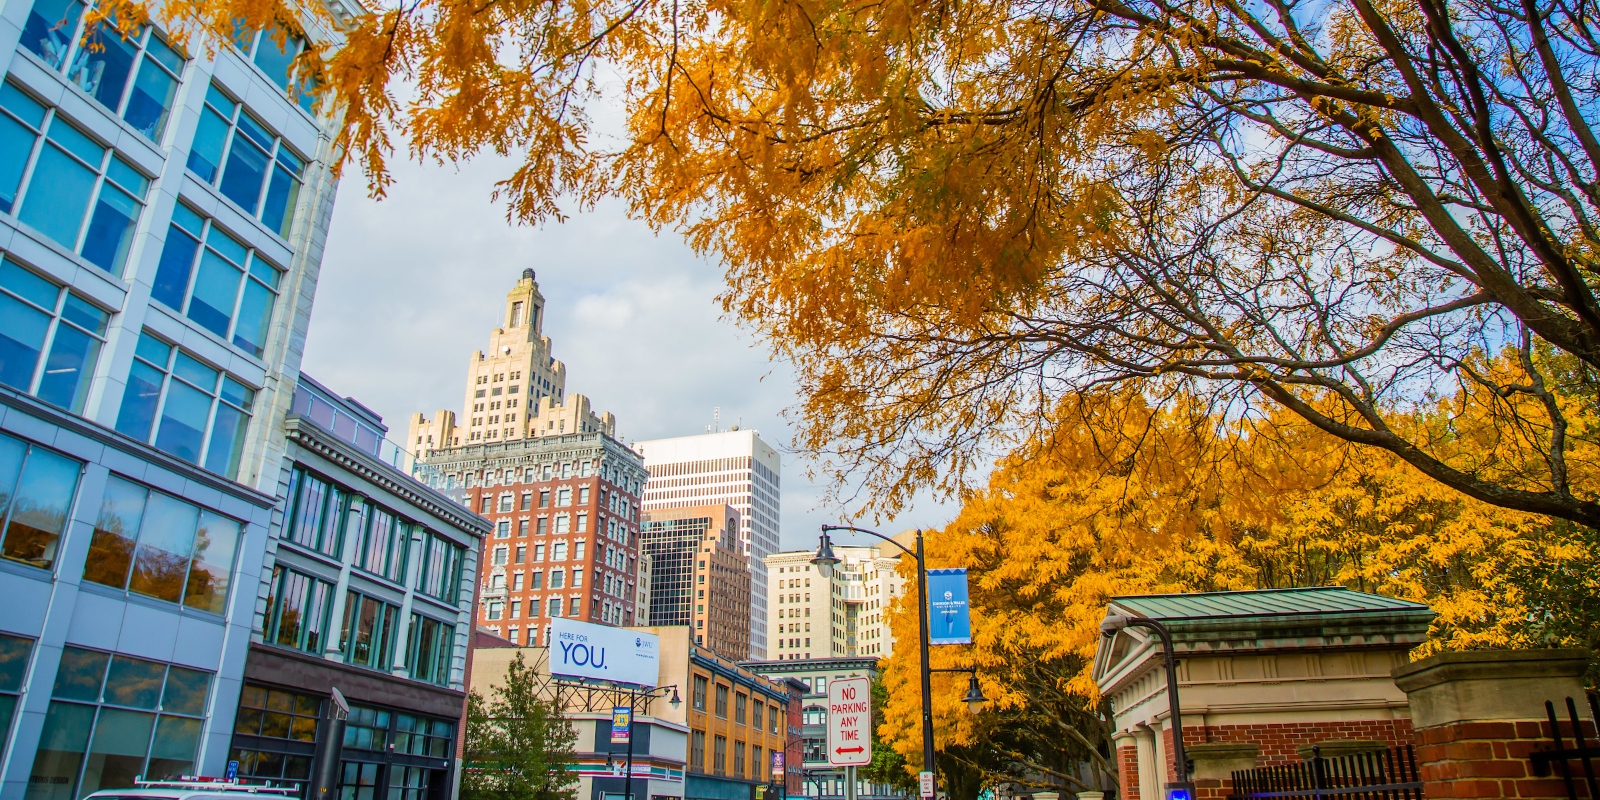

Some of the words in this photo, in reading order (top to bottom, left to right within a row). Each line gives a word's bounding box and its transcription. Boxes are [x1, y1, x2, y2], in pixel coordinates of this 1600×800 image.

[559, 631, 575, 641] HERE
[576, 634, 588, 643] FOR
[559, 640, 608, 670] YOU.
[842, 687, 856, 701] NO
[831, 701, 867, 715] PARKING
[840, 716, 858, 728] ANY
[840, 729, 859, 741] TIME
